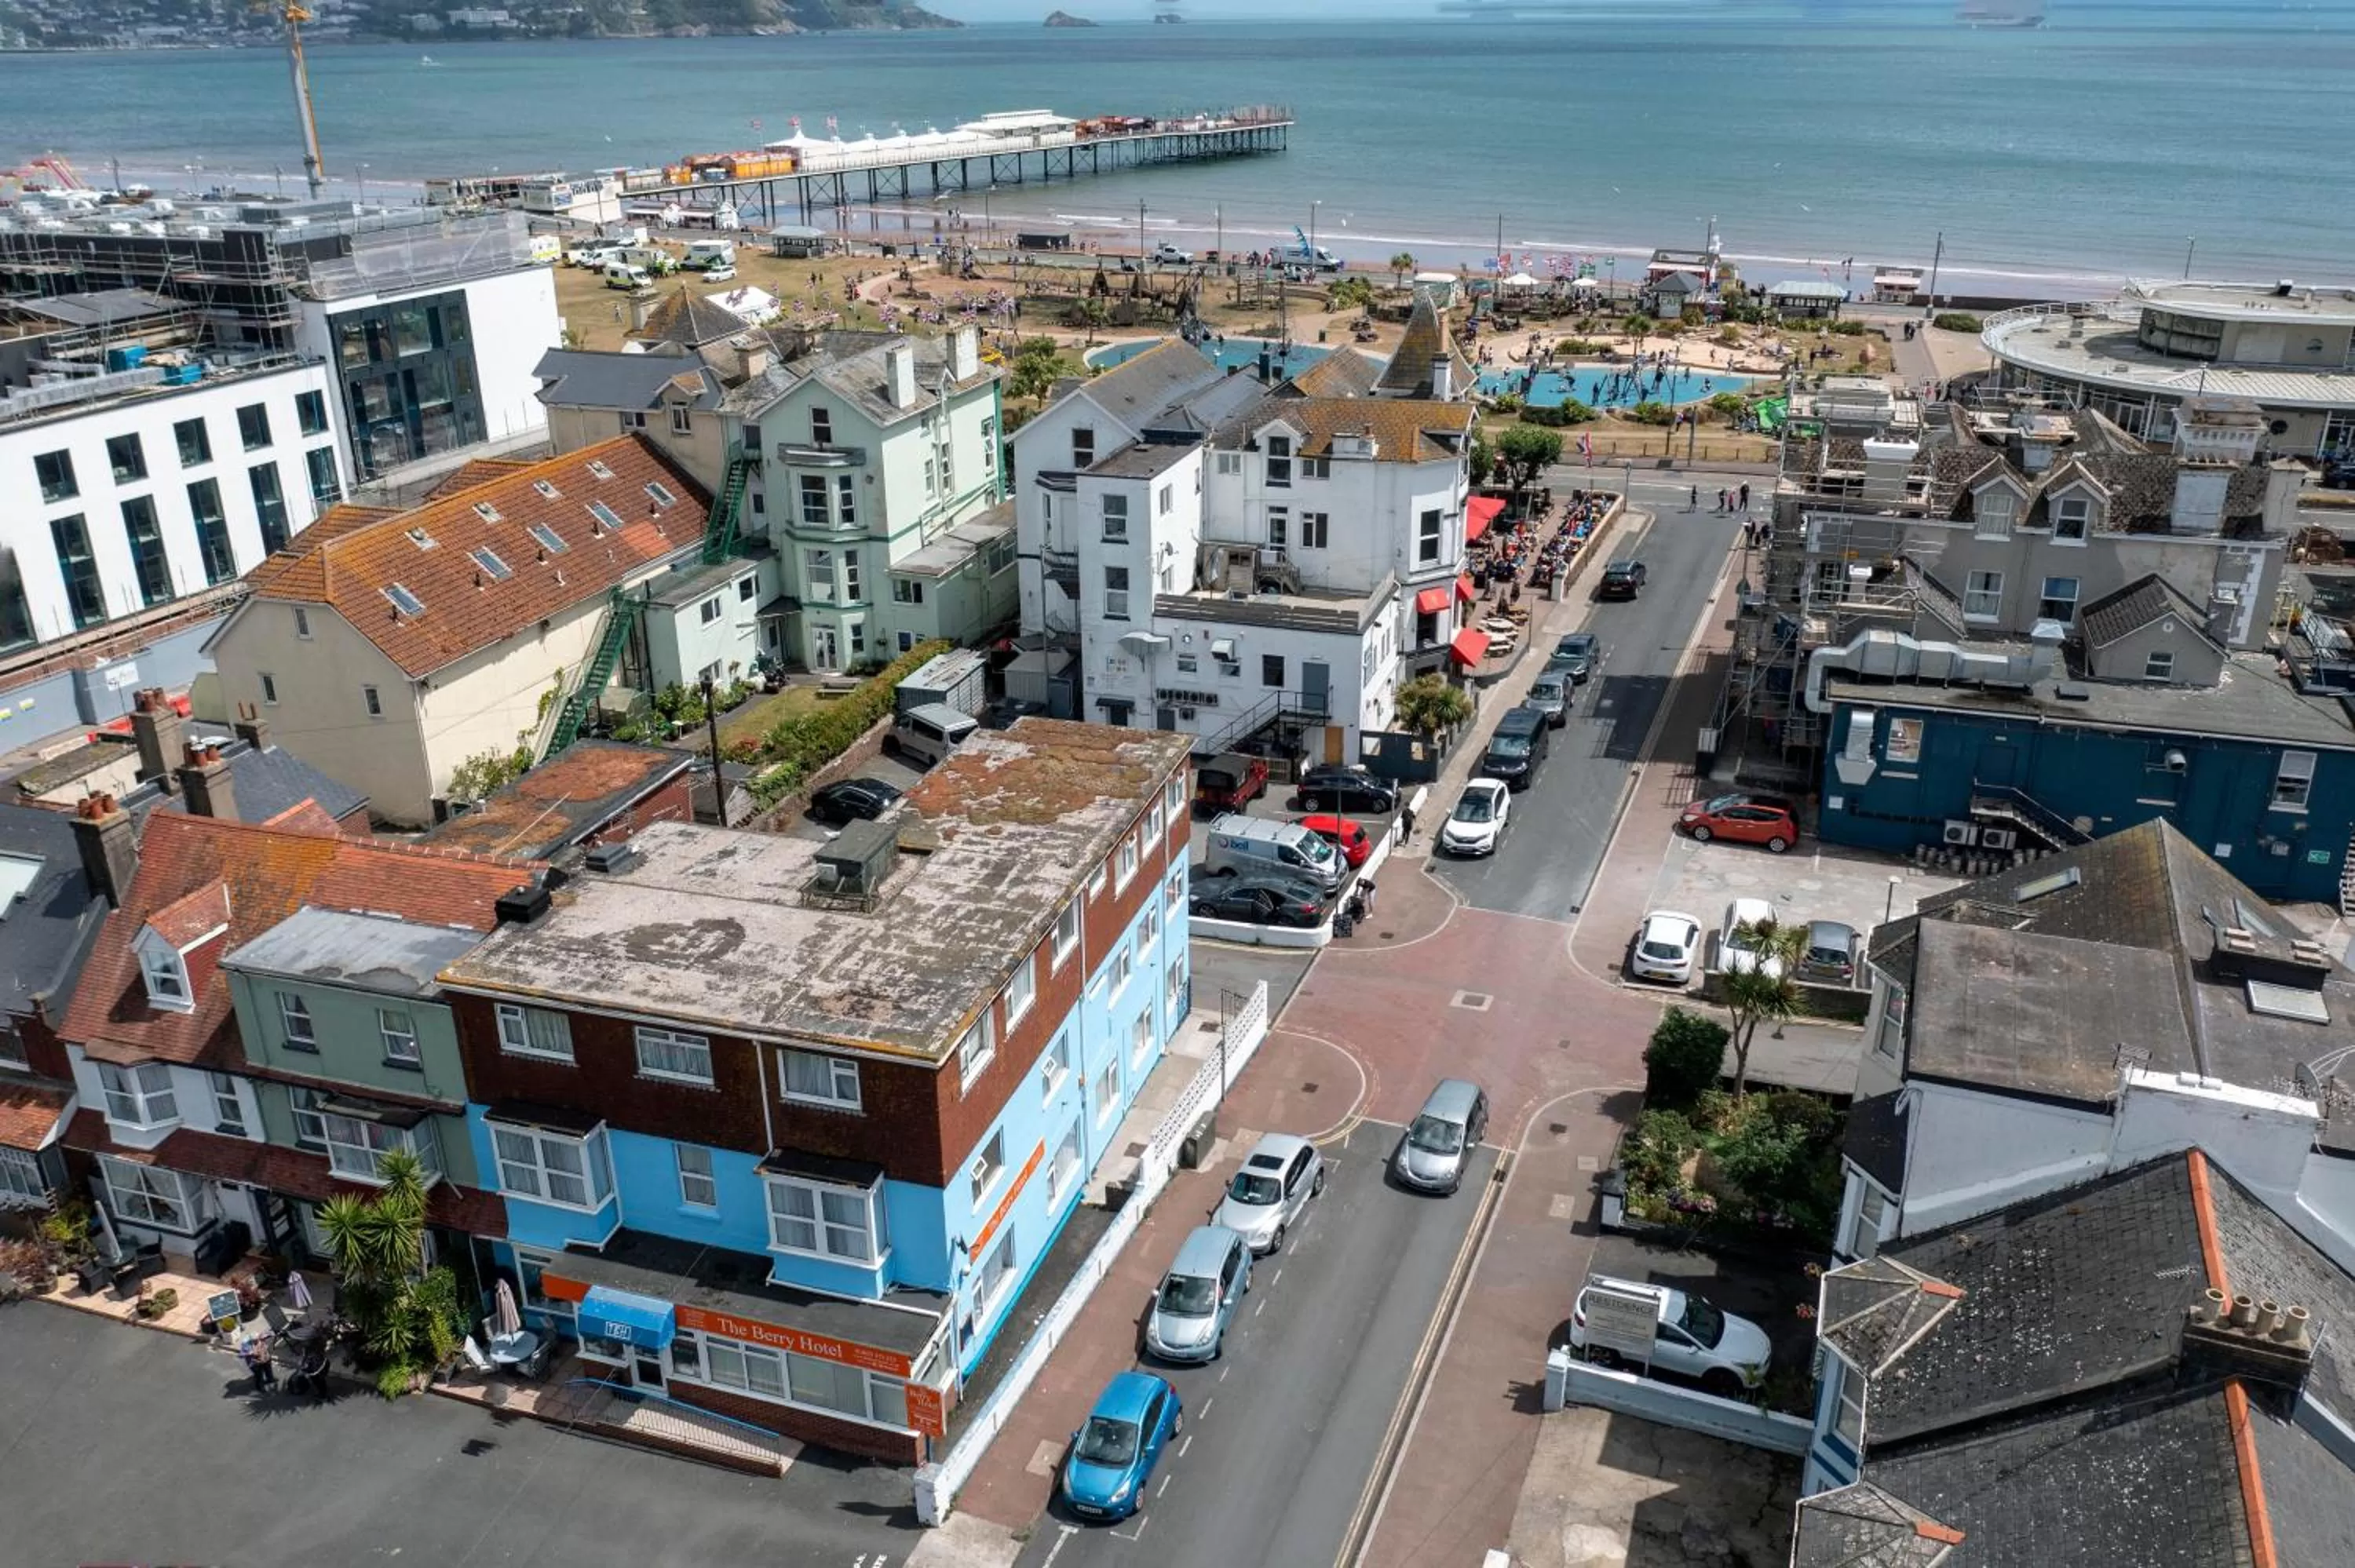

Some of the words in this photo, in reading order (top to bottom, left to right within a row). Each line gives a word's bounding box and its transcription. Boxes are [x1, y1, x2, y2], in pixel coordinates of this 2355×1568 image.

[717, 1318, 747, 1336] The
[752, 1325, 794, 1349] Berry
[799, 1335, 842, 1358] Hotel
